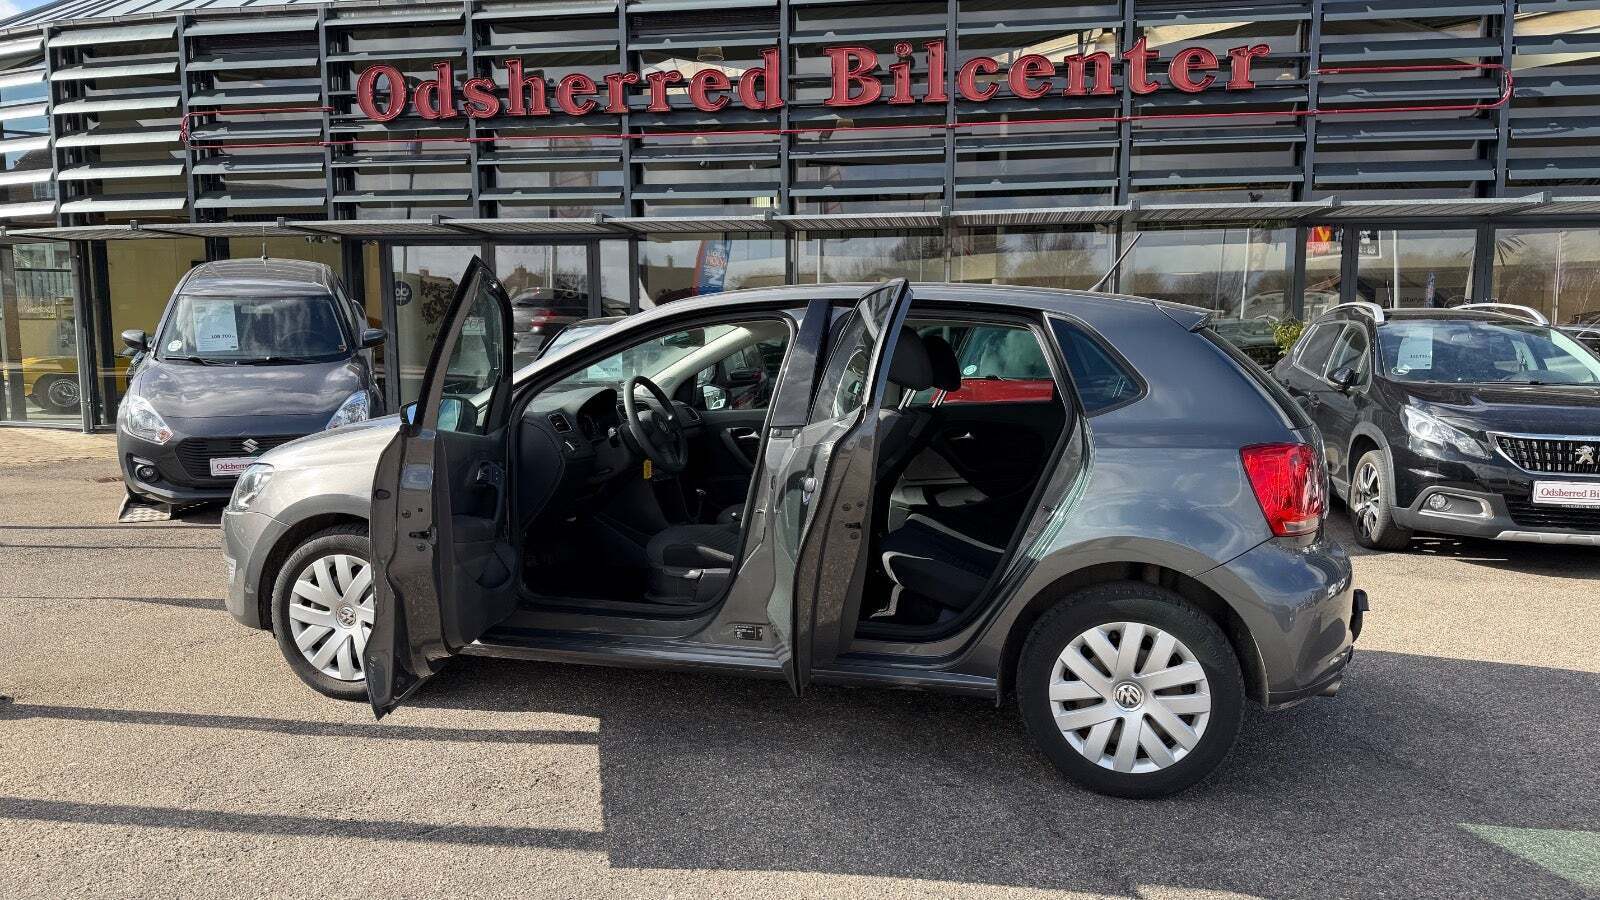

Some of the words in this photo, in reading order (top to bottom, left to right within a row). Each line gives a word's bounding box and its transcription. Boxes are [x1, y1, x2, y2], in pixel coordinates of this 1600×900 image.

[356, 47, 784, 122] Odsherred
[823, 35, 1271, 107] Bilcenter
[1541, 488, 1587, 497] Odsherred
